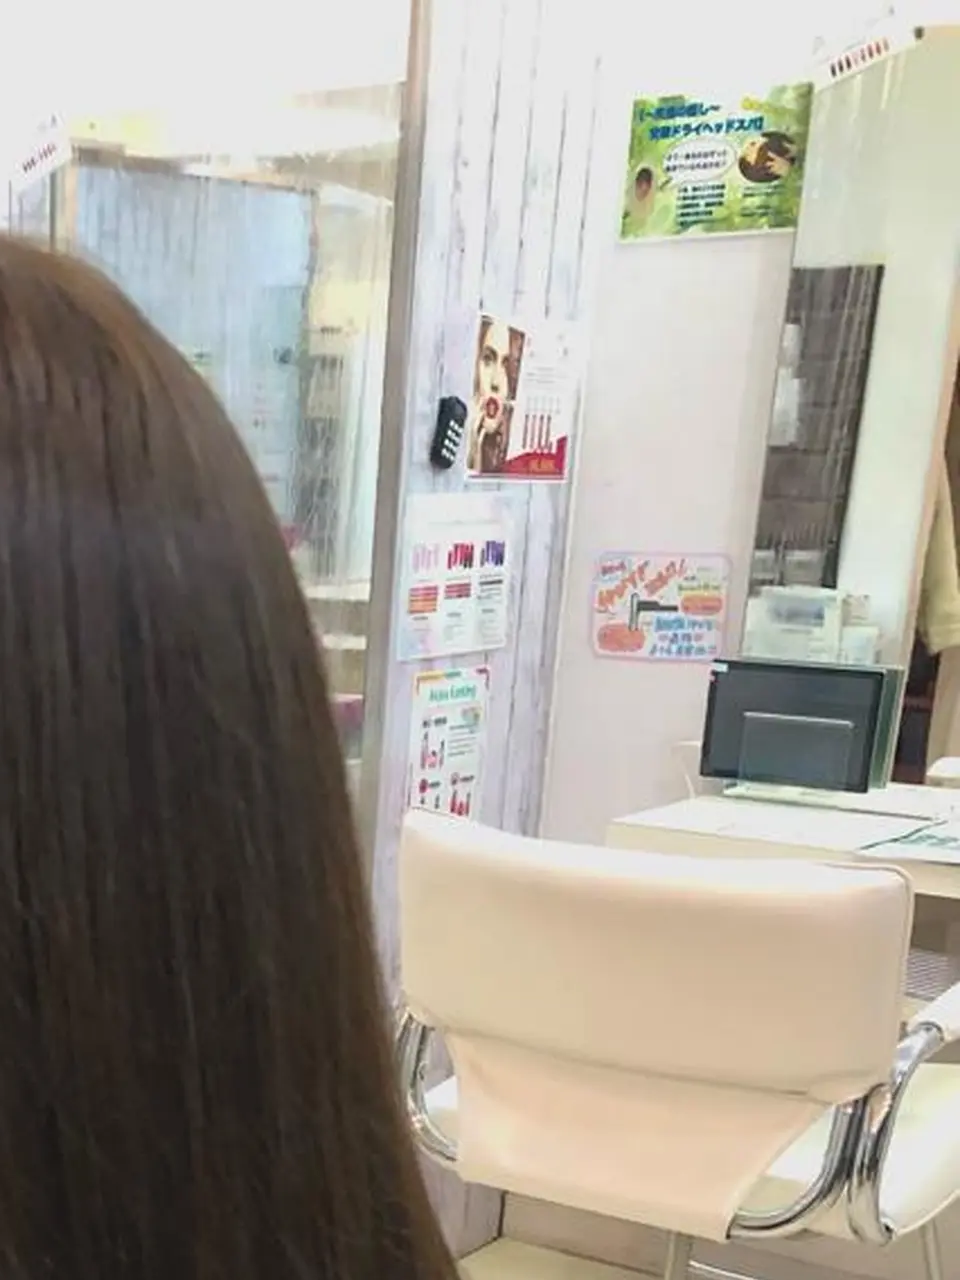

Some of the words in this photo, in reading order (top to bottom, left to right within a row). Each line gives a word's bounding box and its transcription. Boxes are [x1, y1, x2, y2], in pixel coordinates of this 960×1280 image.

[648, 116, 764, 141] ドライヘッドスパ
